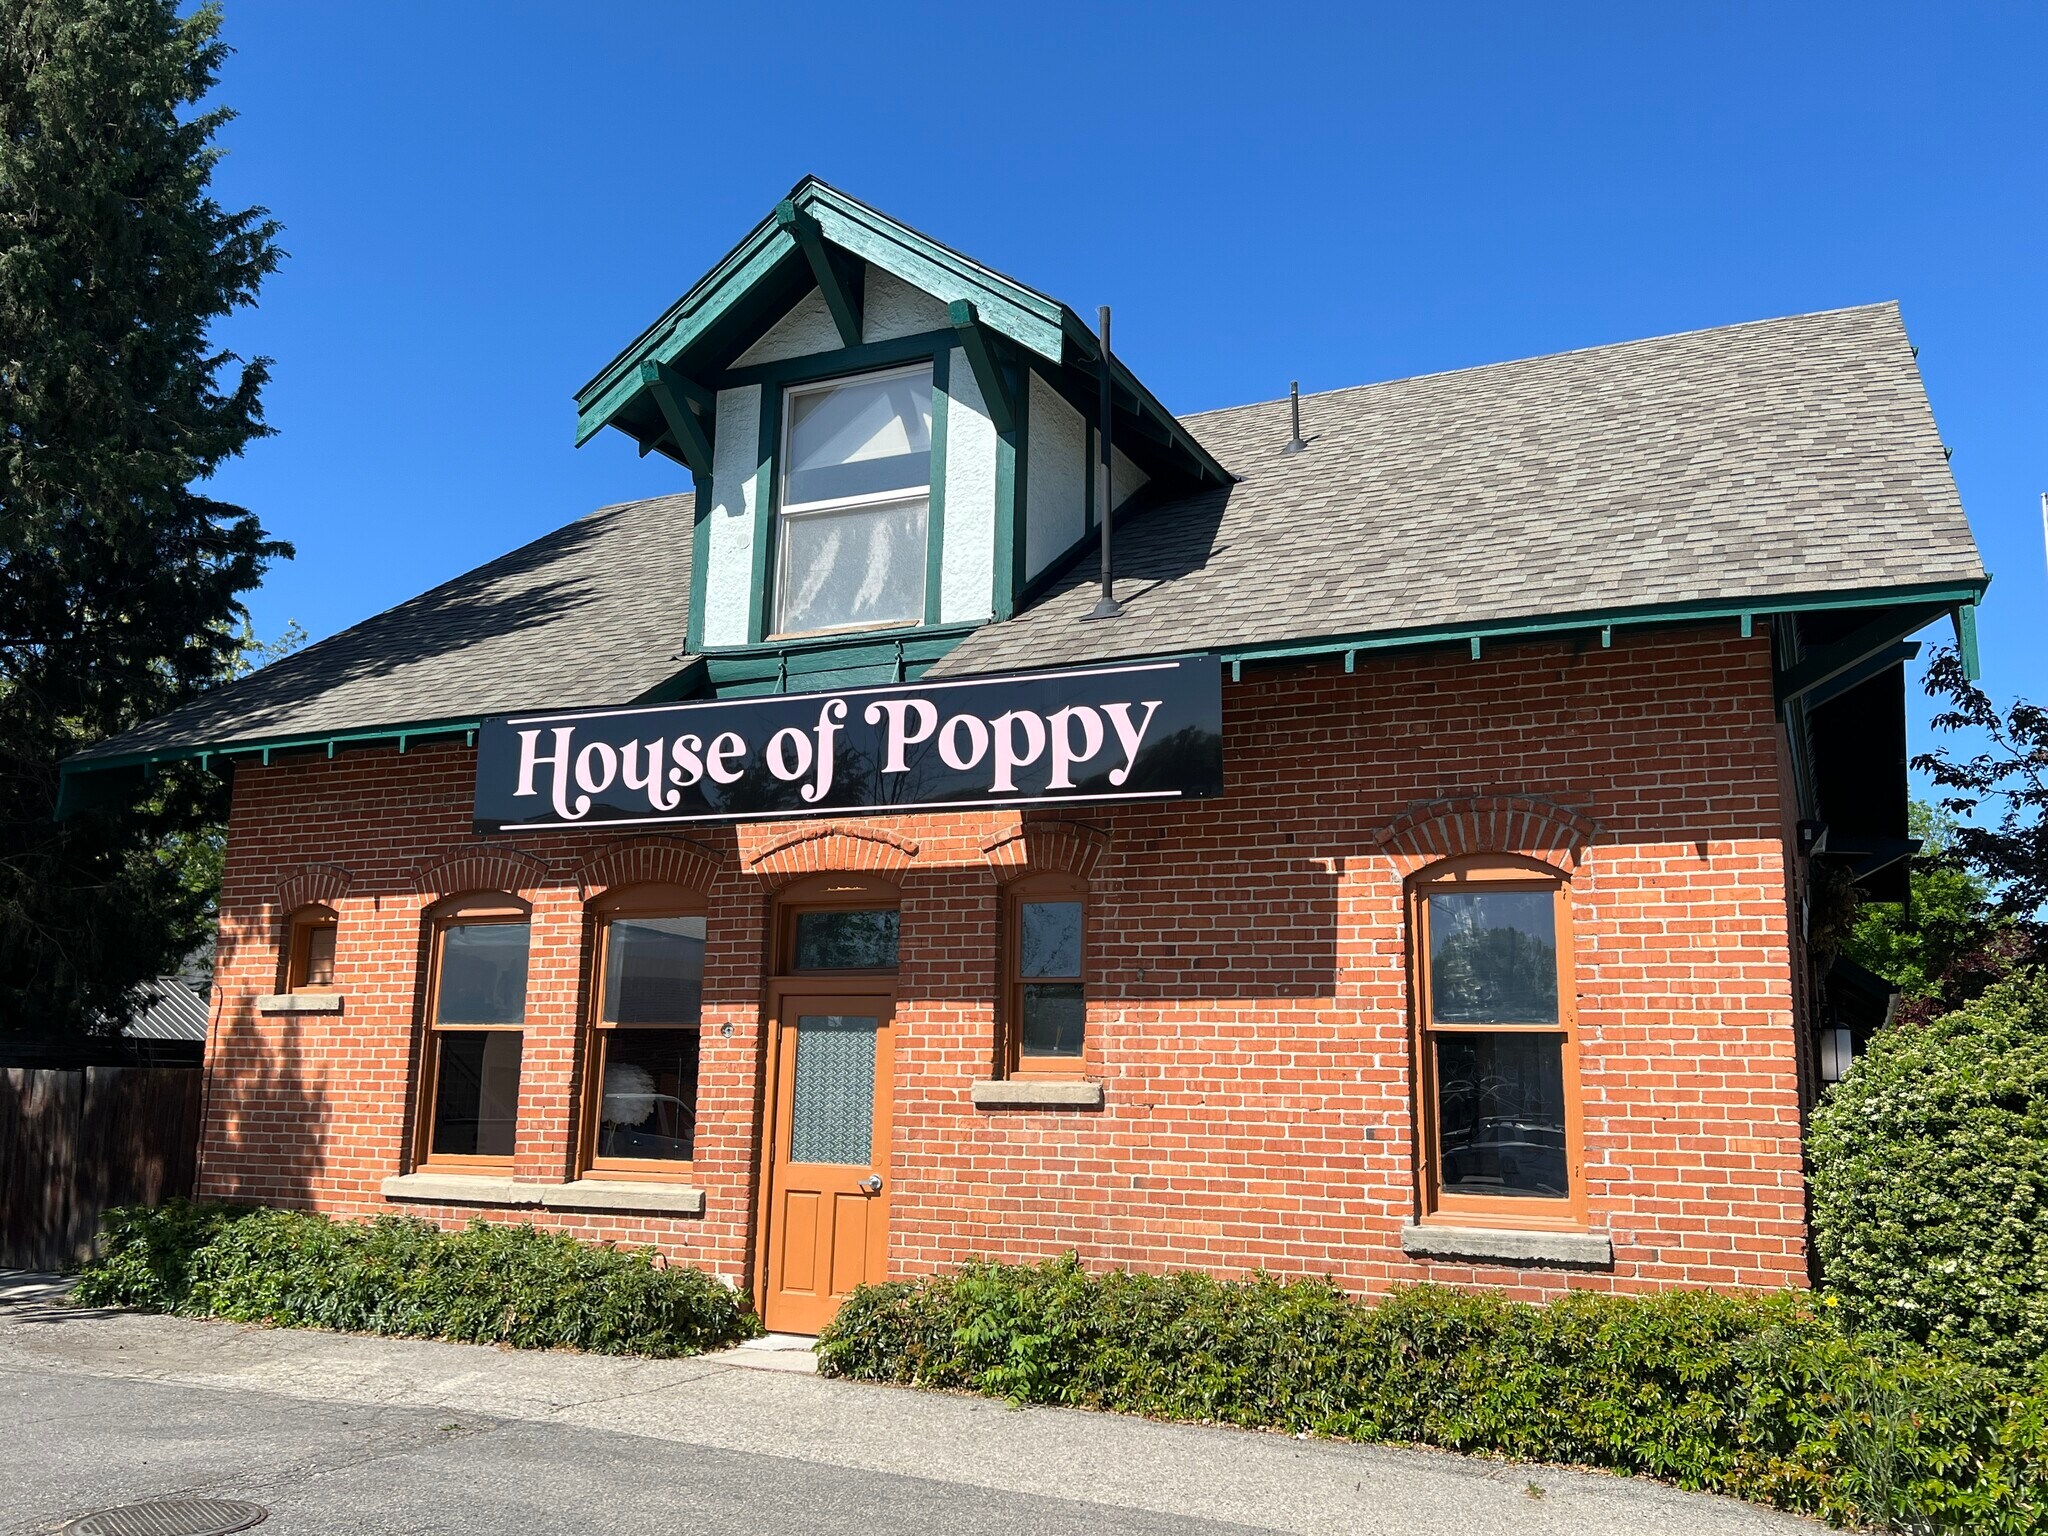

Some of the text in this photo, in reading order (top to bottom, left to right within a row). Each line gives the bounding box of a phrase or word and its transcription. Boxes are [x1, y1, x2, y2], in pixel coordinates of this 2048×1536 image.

[513, 699, 1163, 820] House of Poppy
